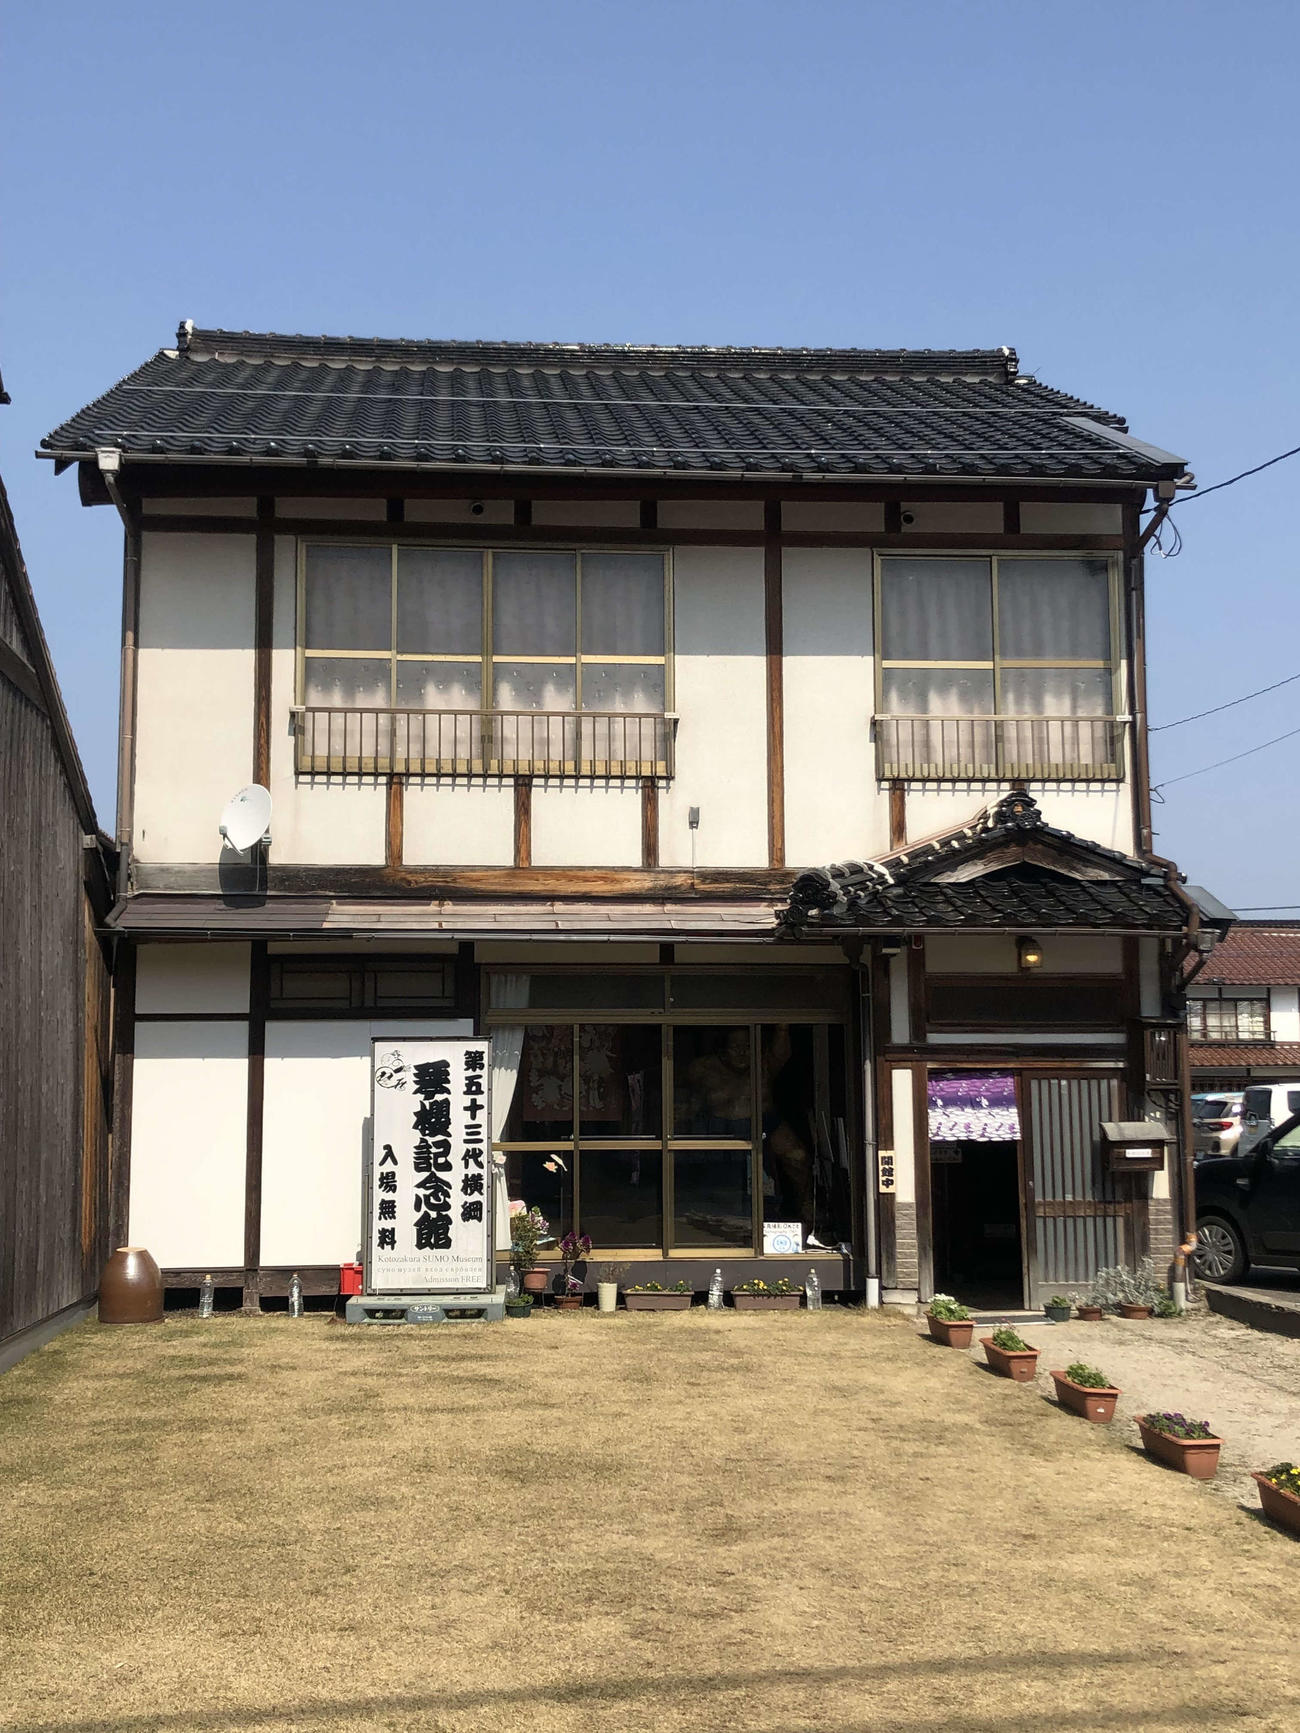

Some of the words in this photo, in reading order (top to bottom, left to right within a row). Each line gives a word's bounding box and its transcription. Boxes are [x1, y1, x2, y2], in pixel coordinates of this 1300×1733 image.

[412, 1059, 452, 1250] 琴櫻記念館
[461, 1050, 485, 1222] 第五十三代横綱
[377, 1144, 398, 1250] 入場無料
[377, 1255, 420, 1263] Kotozakura
[422, 1255, 449, 1263] SUMO
[451, 1255, 483, 1263] Museum
[461, 1275, 482, 1283] FREE
